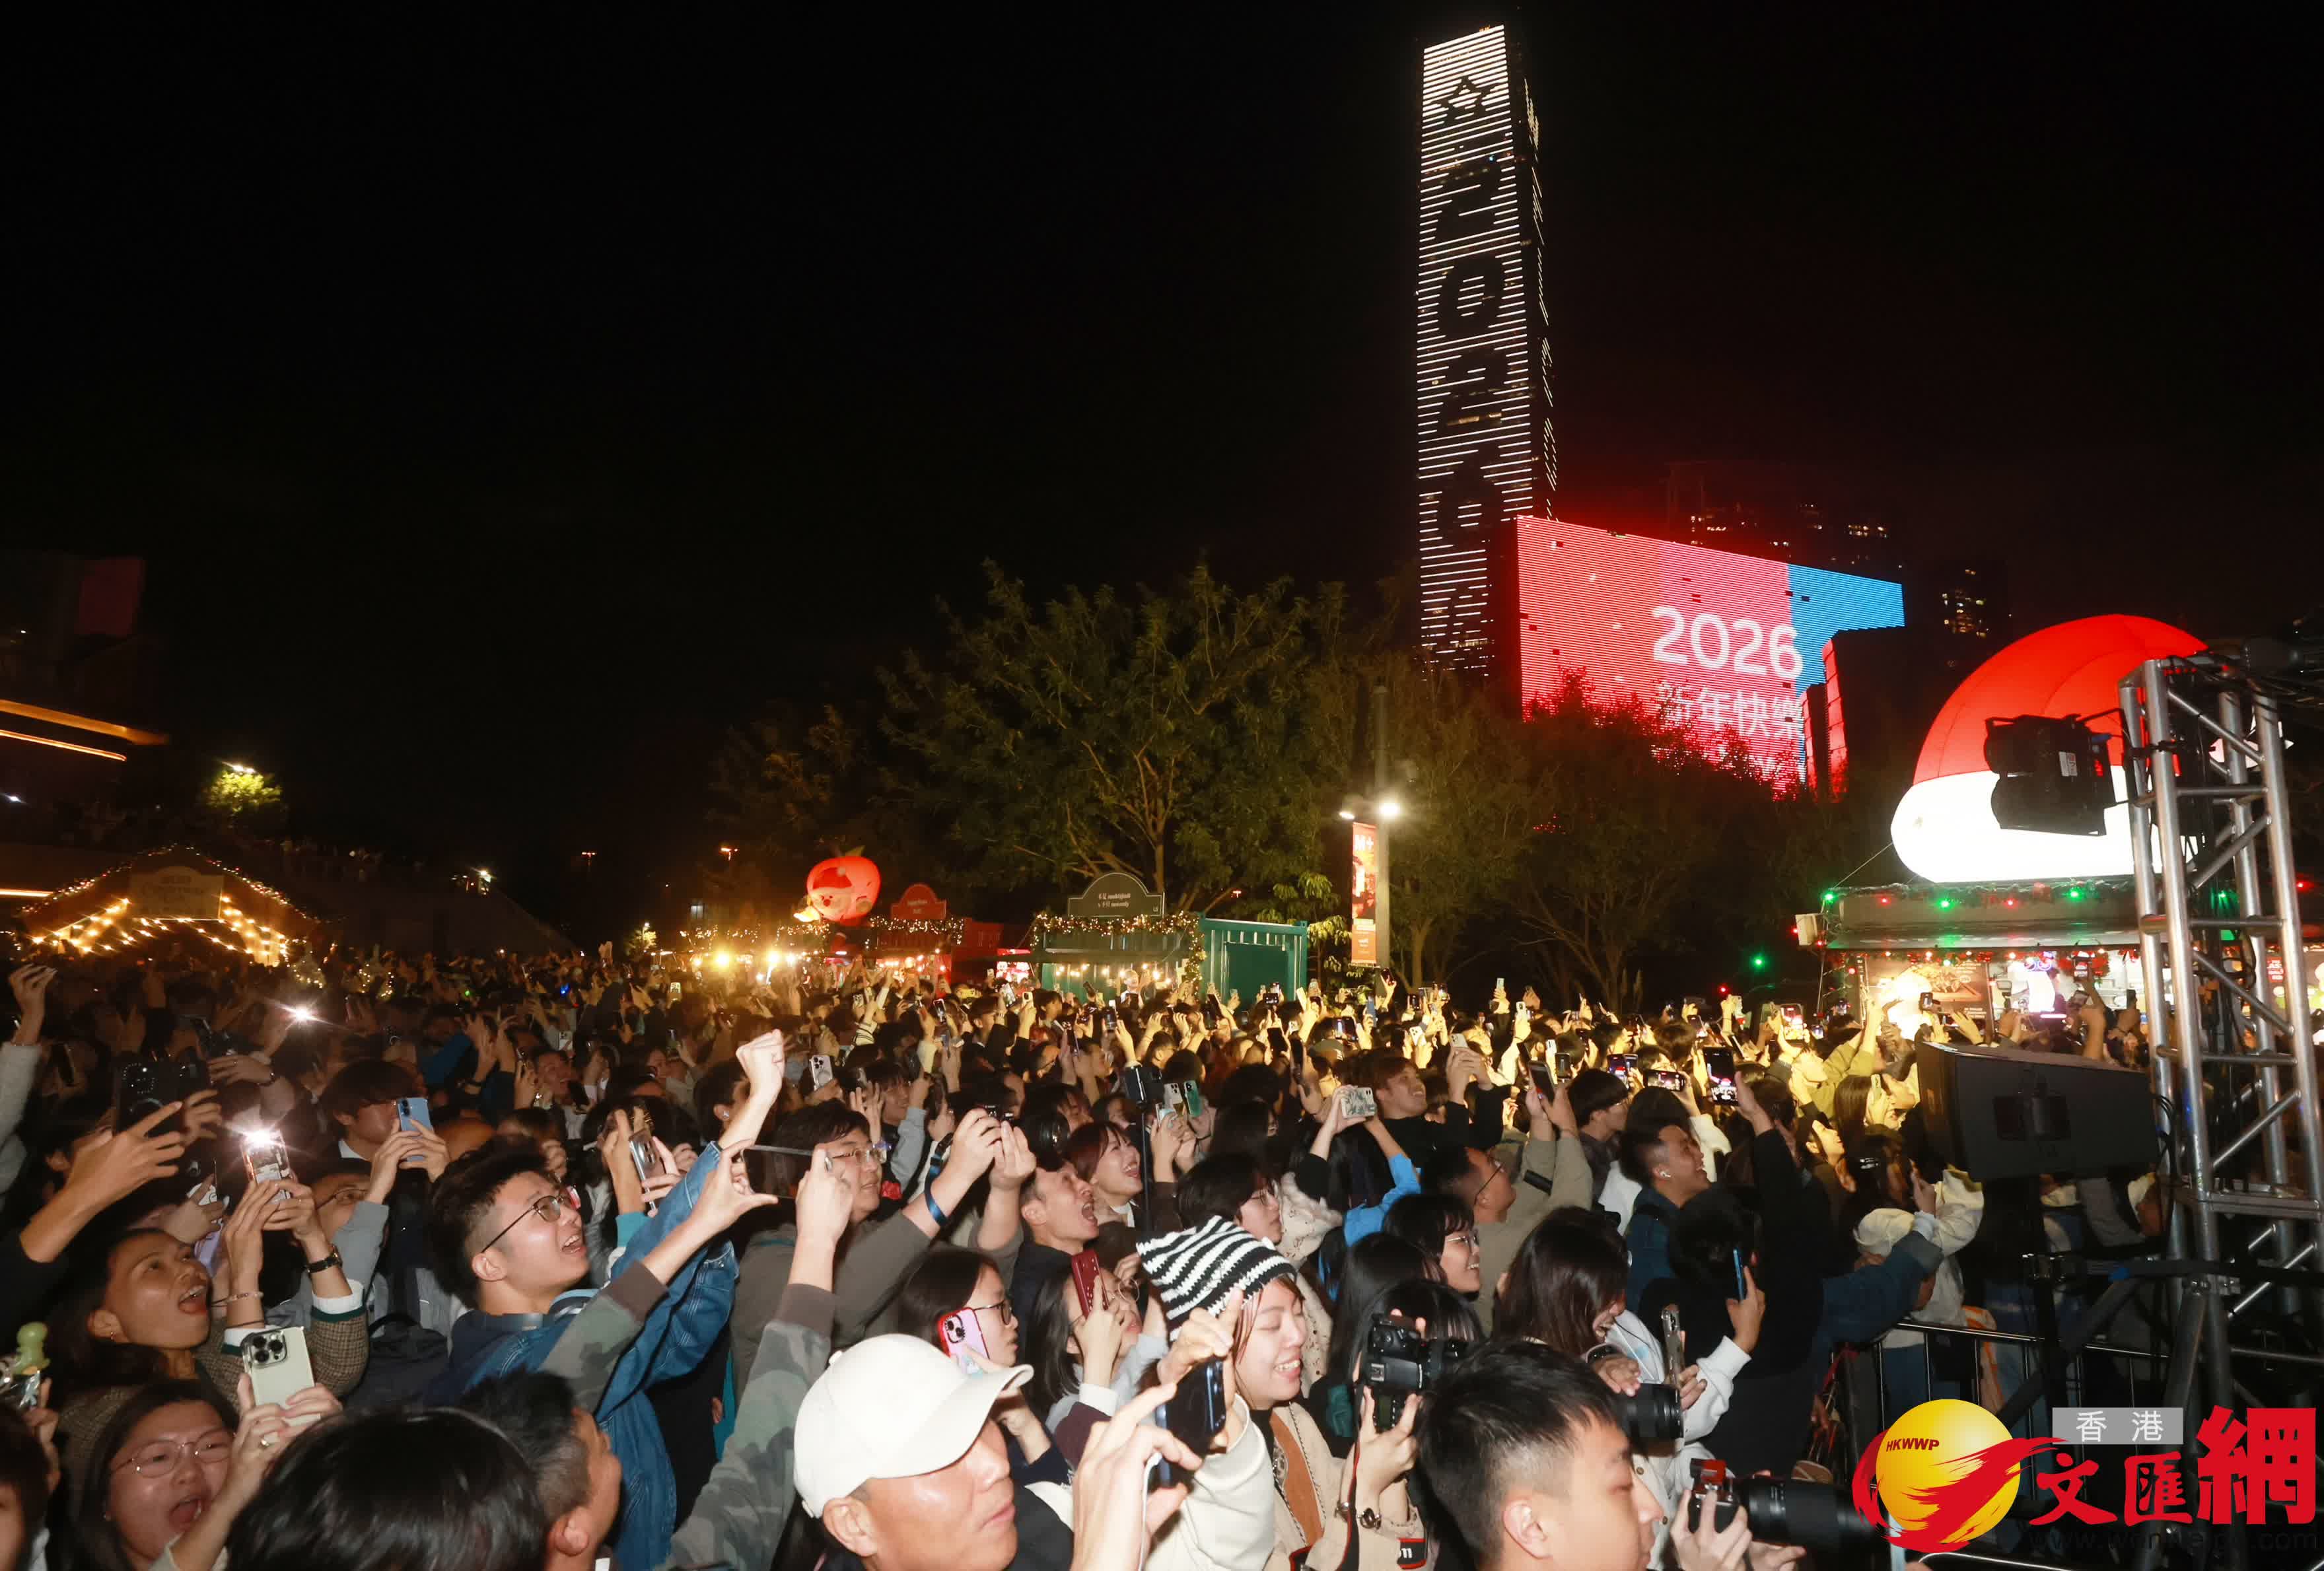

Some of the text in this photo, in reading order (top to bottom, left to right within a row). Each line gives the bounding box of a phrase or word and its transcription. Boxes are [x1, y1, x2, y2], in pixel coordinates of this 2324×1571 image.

[1651, 606, 1804, 680] 2026
[1655, 680, 1804, 740] 新年快樂
[1355, 833, 1374, 851] M+
